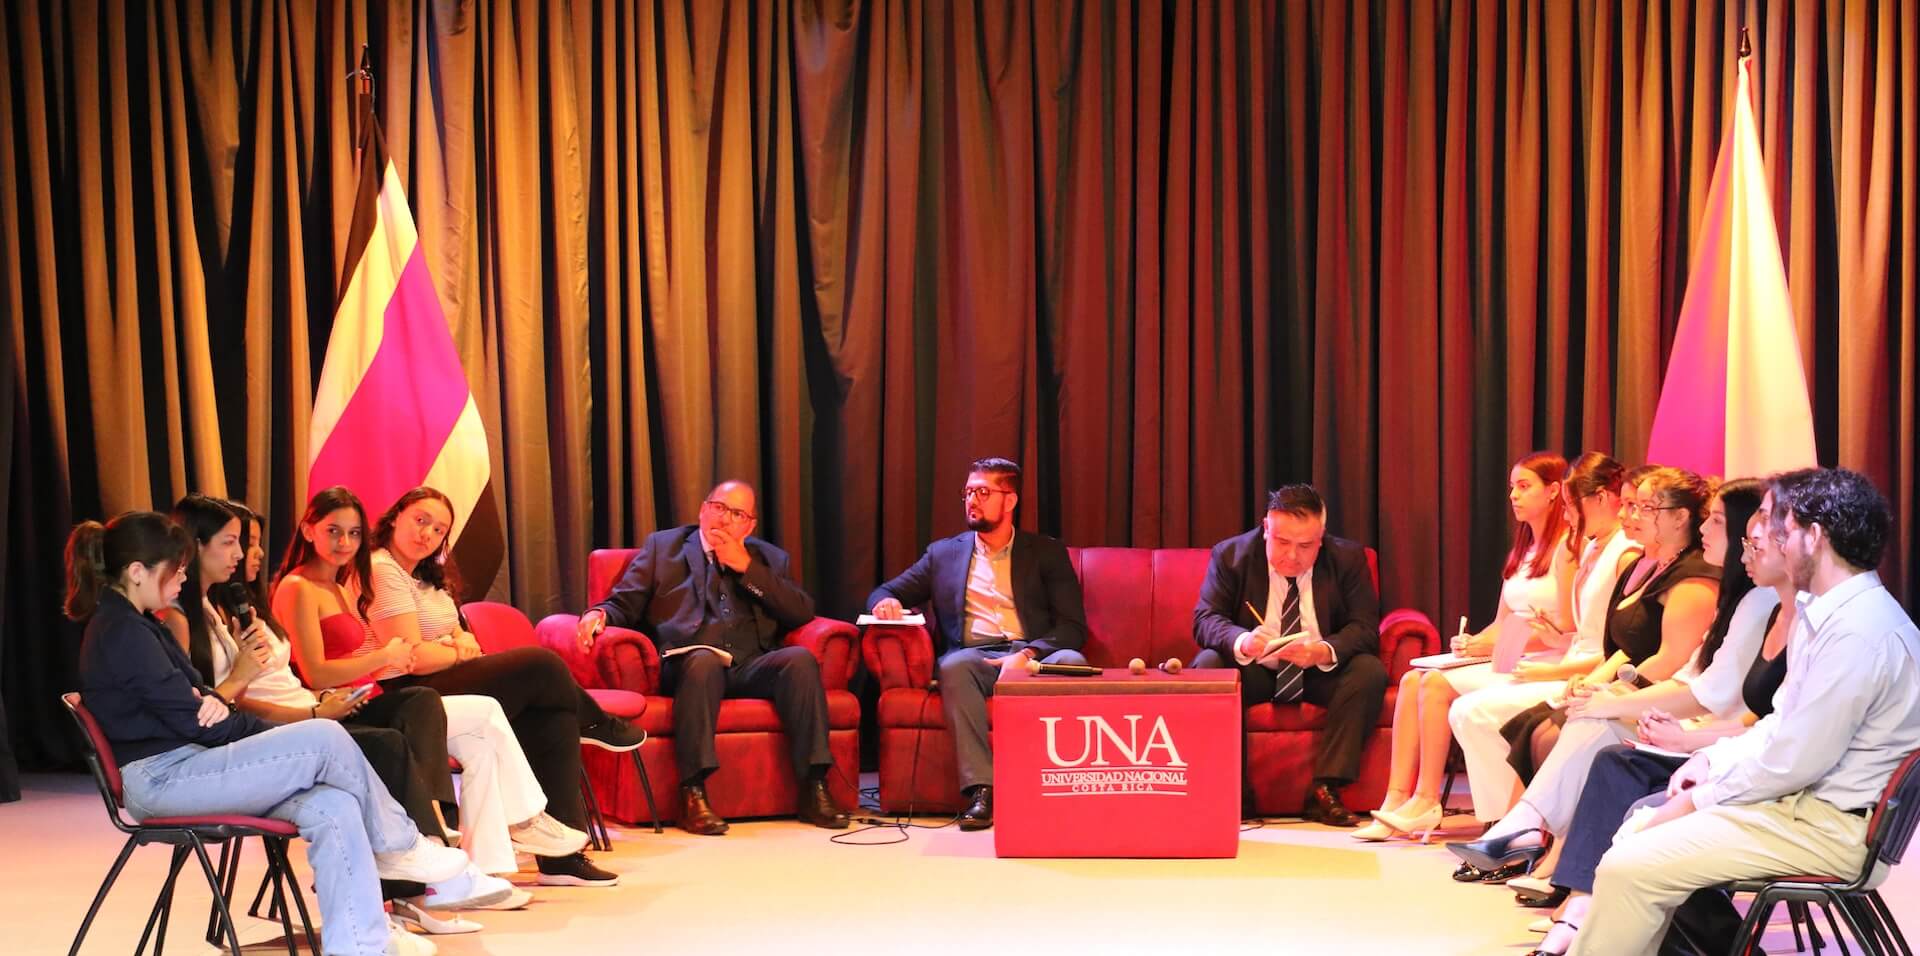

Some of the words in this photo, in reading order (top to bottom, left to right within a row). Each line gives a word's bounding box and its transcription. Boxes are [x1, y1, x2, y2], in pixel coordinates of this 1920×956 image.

[1040, 715, 1188, 767] UNA
[1042, 771, 1122, 784] UNIVERSIDAD
[1124, 770, 1187, 784] NACIONAL
[1072, 784, 1114, 792] COSTA
[1122, 783, 1154, 791] RICA
